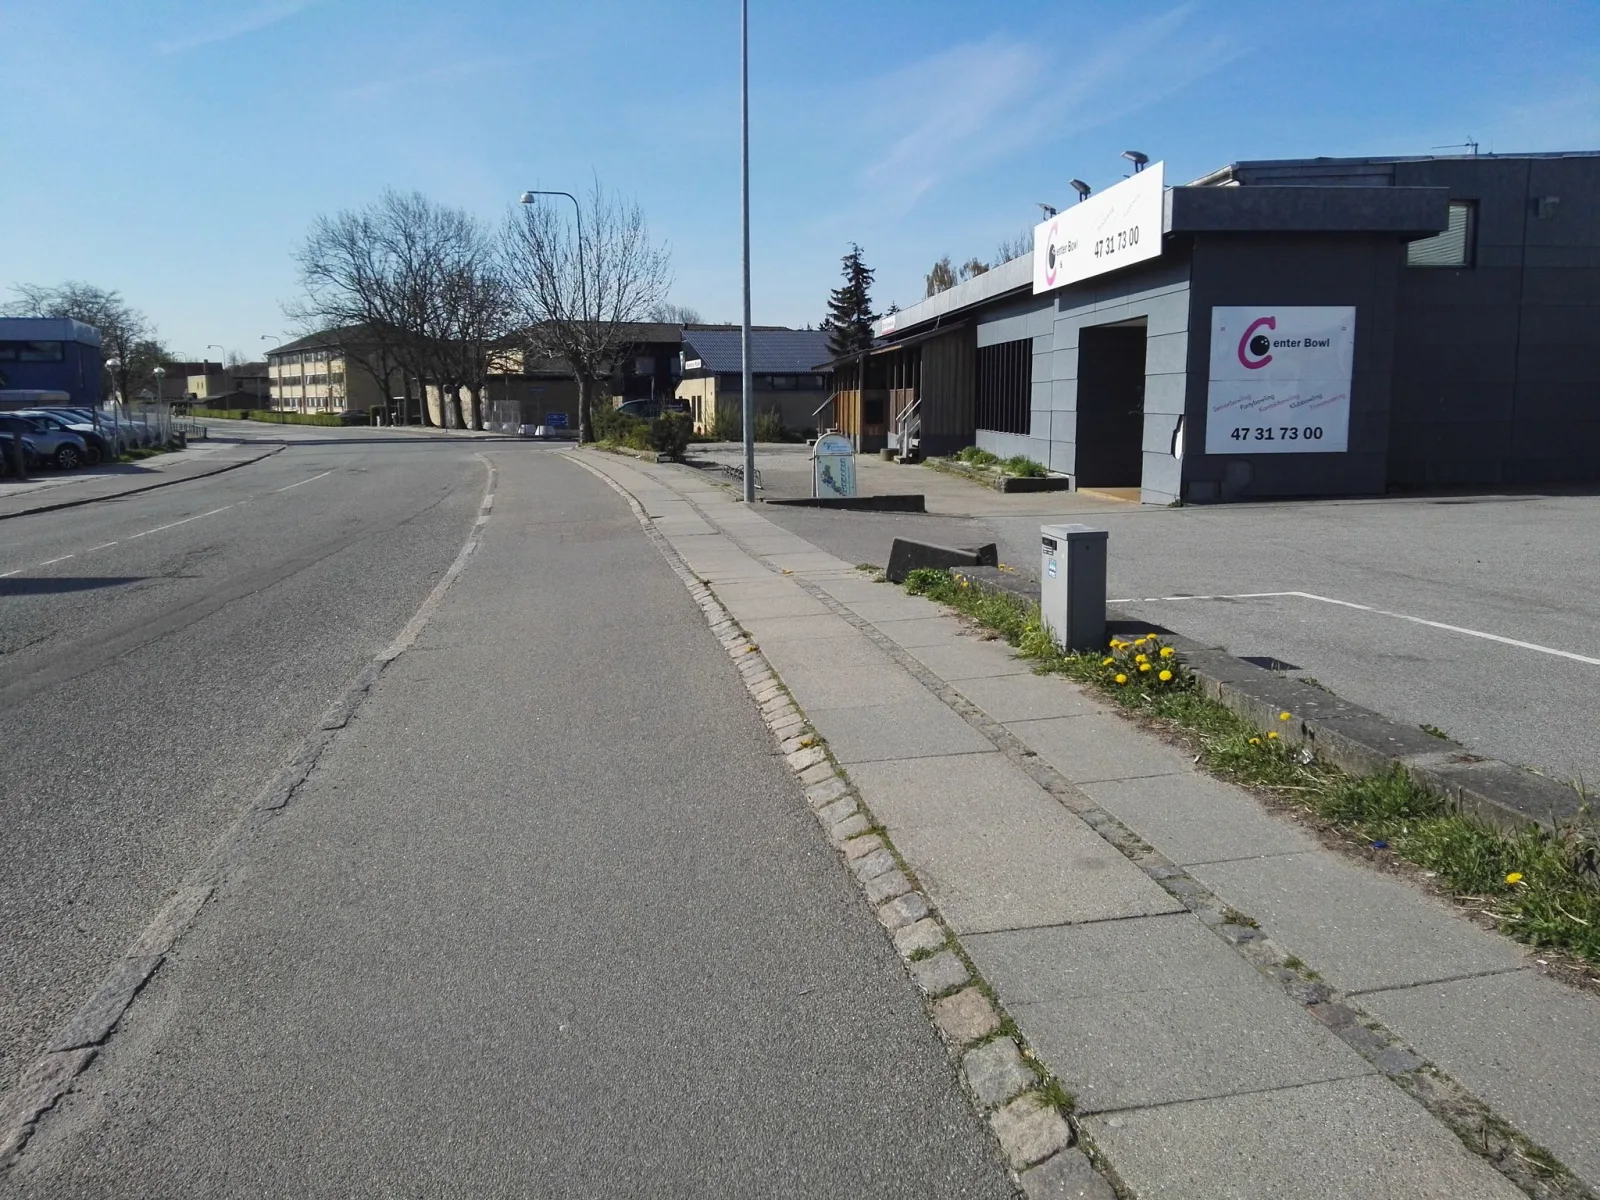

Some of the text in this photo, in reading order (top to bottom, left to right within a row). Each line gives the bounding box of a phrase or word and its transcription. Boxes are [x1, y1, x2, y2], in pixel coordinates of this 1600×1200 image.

[1094, 225, 1140, 259] 47 31 73 00
[1303, 338, 1330, 348] Bowl
[1230, 426, 1323, 441] 47 31 73 00
